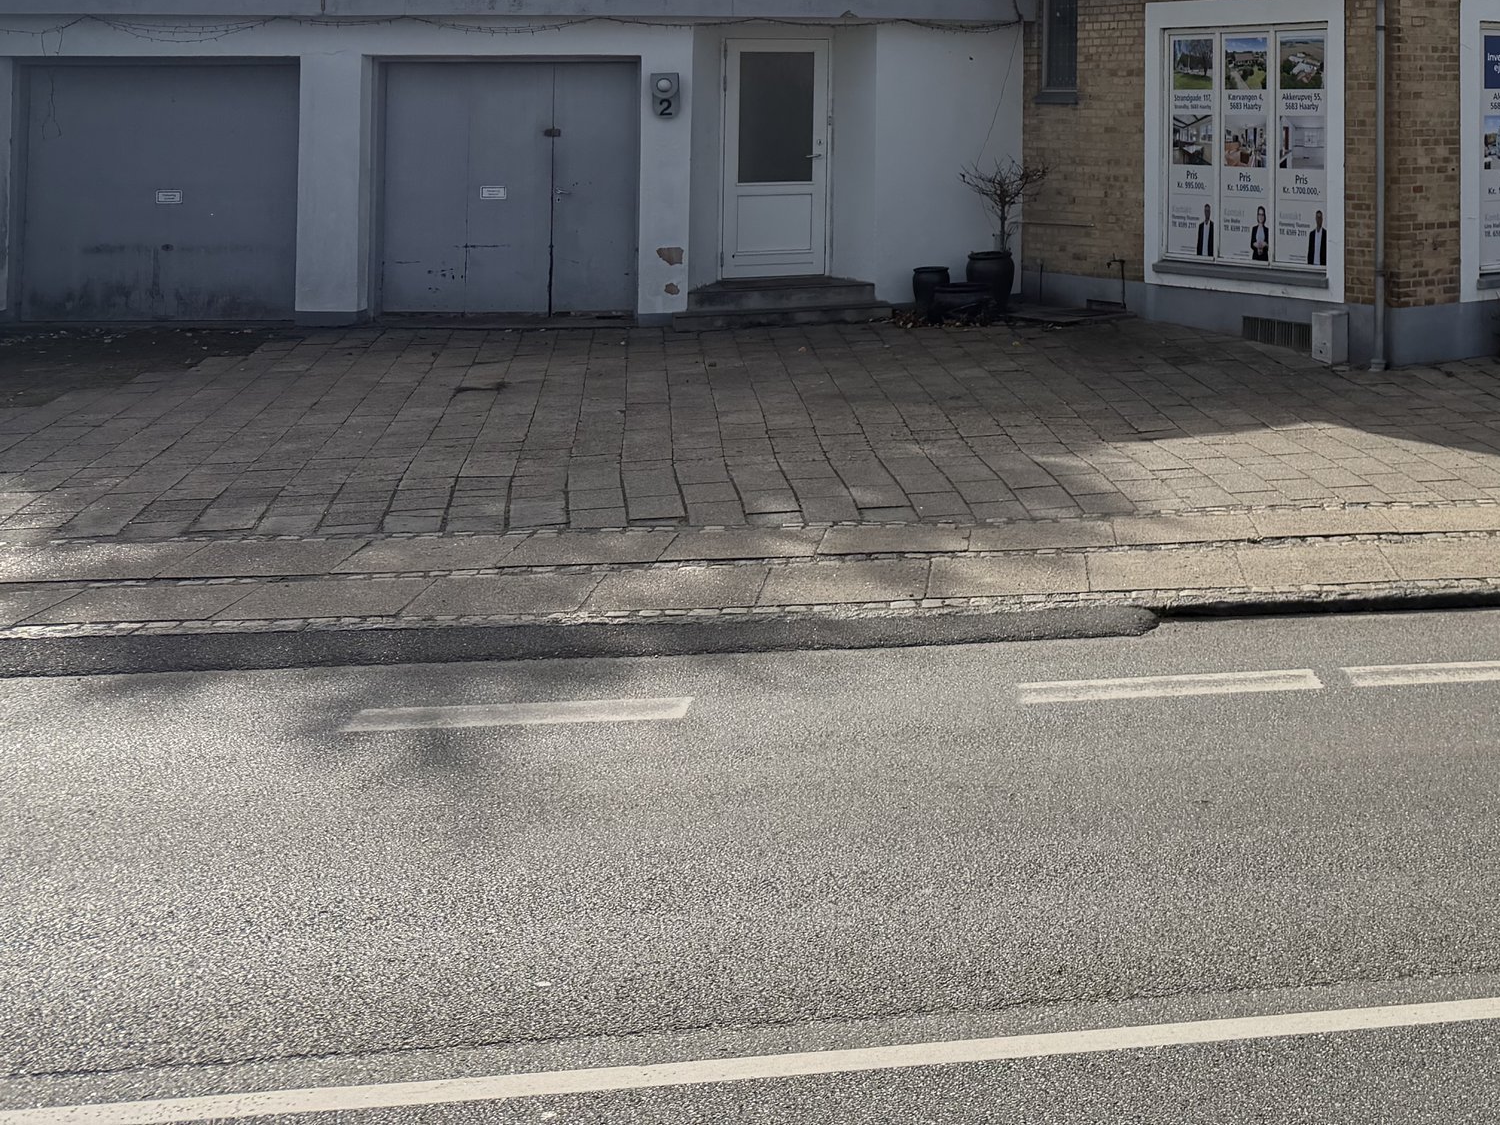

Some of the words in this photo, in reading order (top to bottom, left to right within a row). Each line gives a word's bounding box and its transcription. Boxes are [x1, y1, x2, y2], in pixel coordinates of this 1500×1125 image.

[1282, 93, 1312, 103] Akkerupvej
[1313, 93, 1322, 102] 55,
[659, 98, 673, 116] 2
[1230, 102, 1242, 110] 5683
[1243, 102, 1261, 112] Haarby
[1285, 102, 1298, 110] 5683
[1300, 102, 1319, 112] Haarby
[1187, 170, 1198, 180] Pris
[1239, 172, 1251, 183] Pris
[1295, 174, 1308, 185] Pris
[1282, 186, 1290, 195] Kr.
[1488, 186, 1497, 195] Kr.
